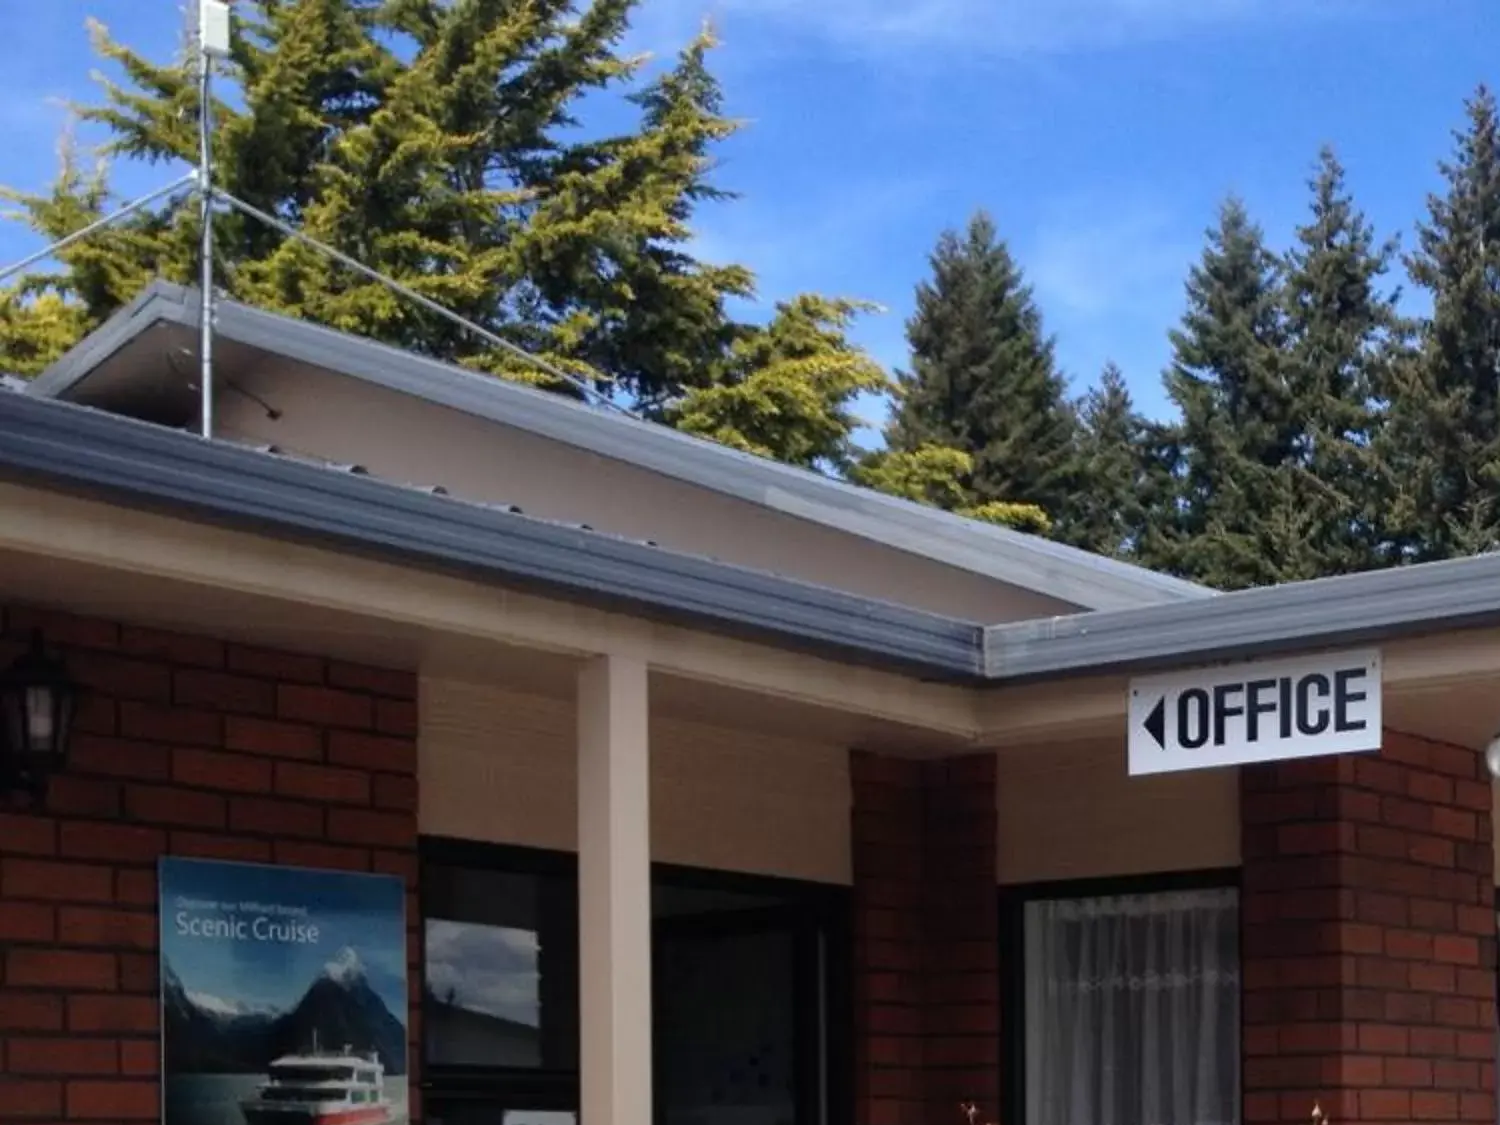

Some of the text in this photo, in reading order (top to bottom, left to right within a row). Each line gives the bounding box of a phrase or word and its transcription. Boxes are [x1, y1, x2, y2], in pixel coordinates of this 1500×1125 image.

[1177, 667, 1367, 749] OFFICE
[176, 911, 320, 943] Scenic Cruise
